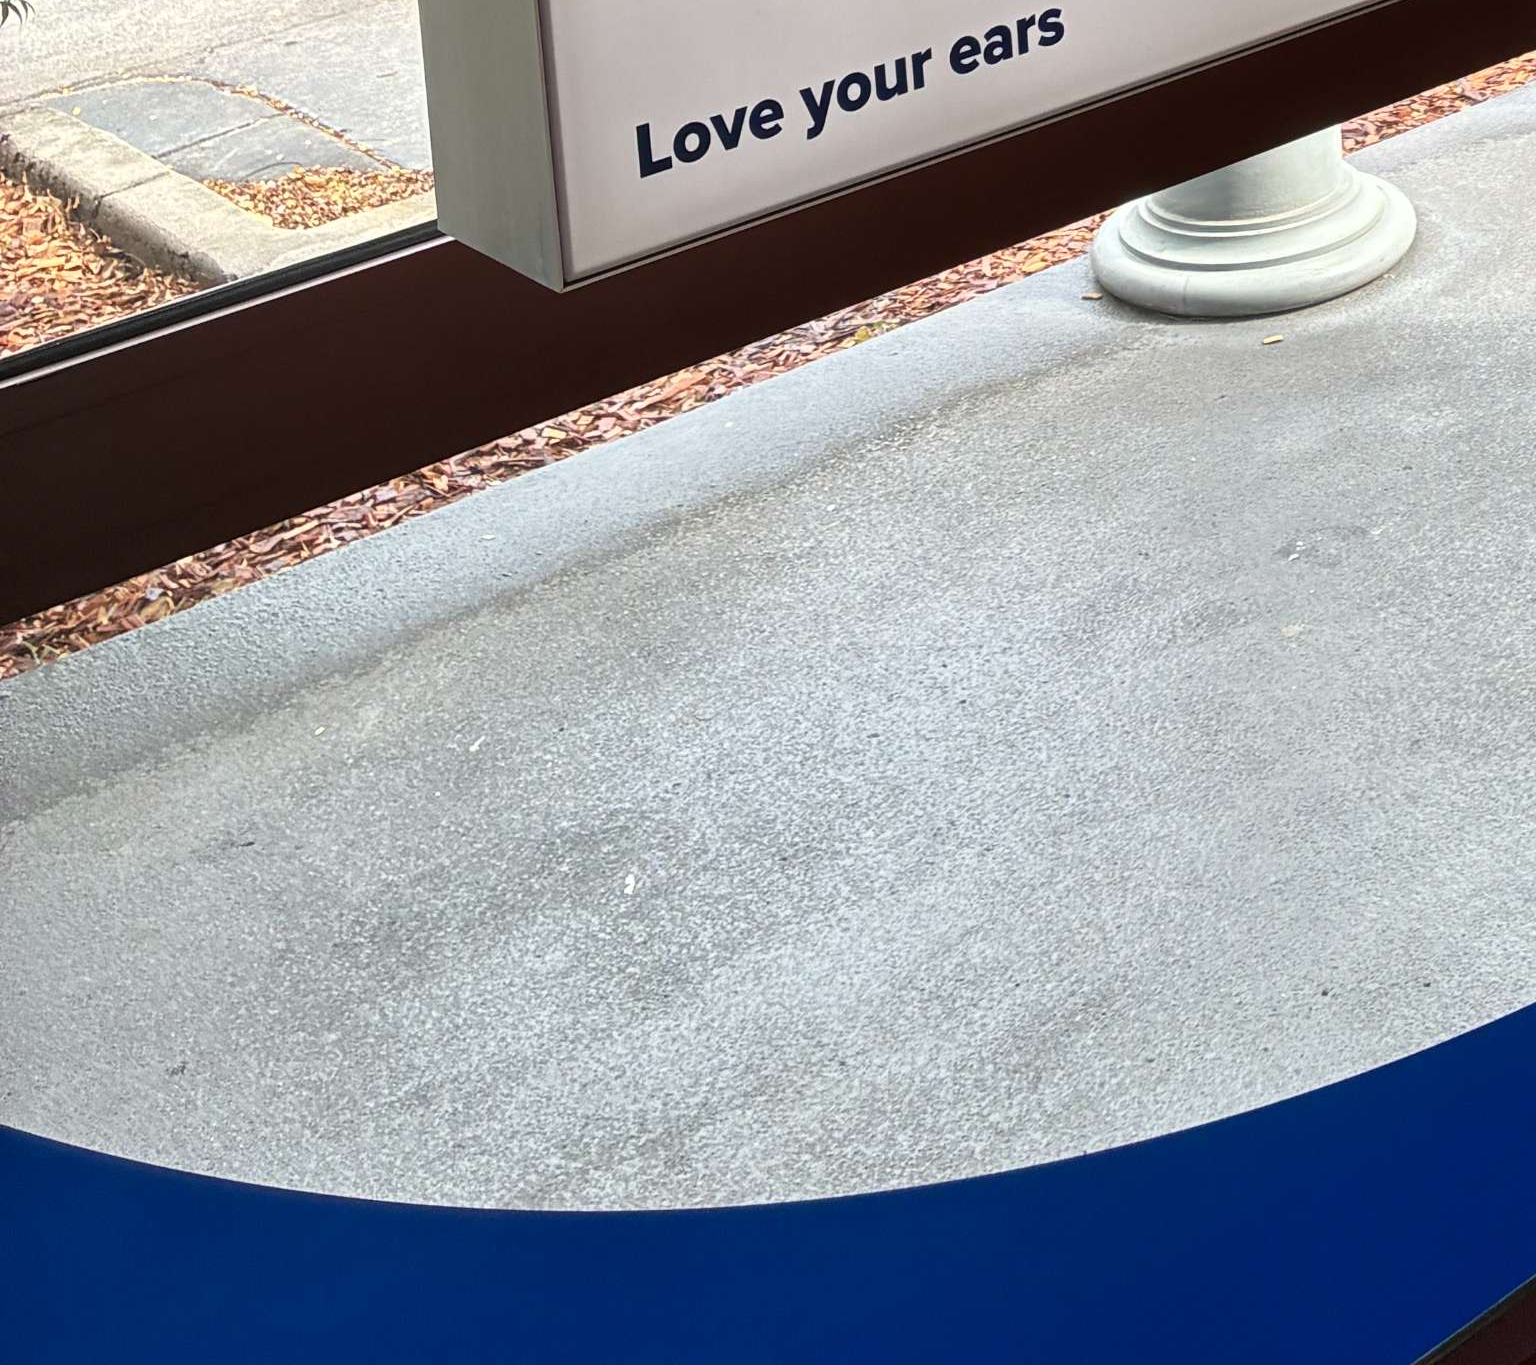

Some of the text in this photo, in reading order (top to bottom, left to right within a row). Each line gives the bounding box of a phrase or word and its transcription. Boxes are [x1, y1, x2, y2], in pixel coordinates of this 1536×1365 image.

[635, 8, 1065, 179] Love your ears
